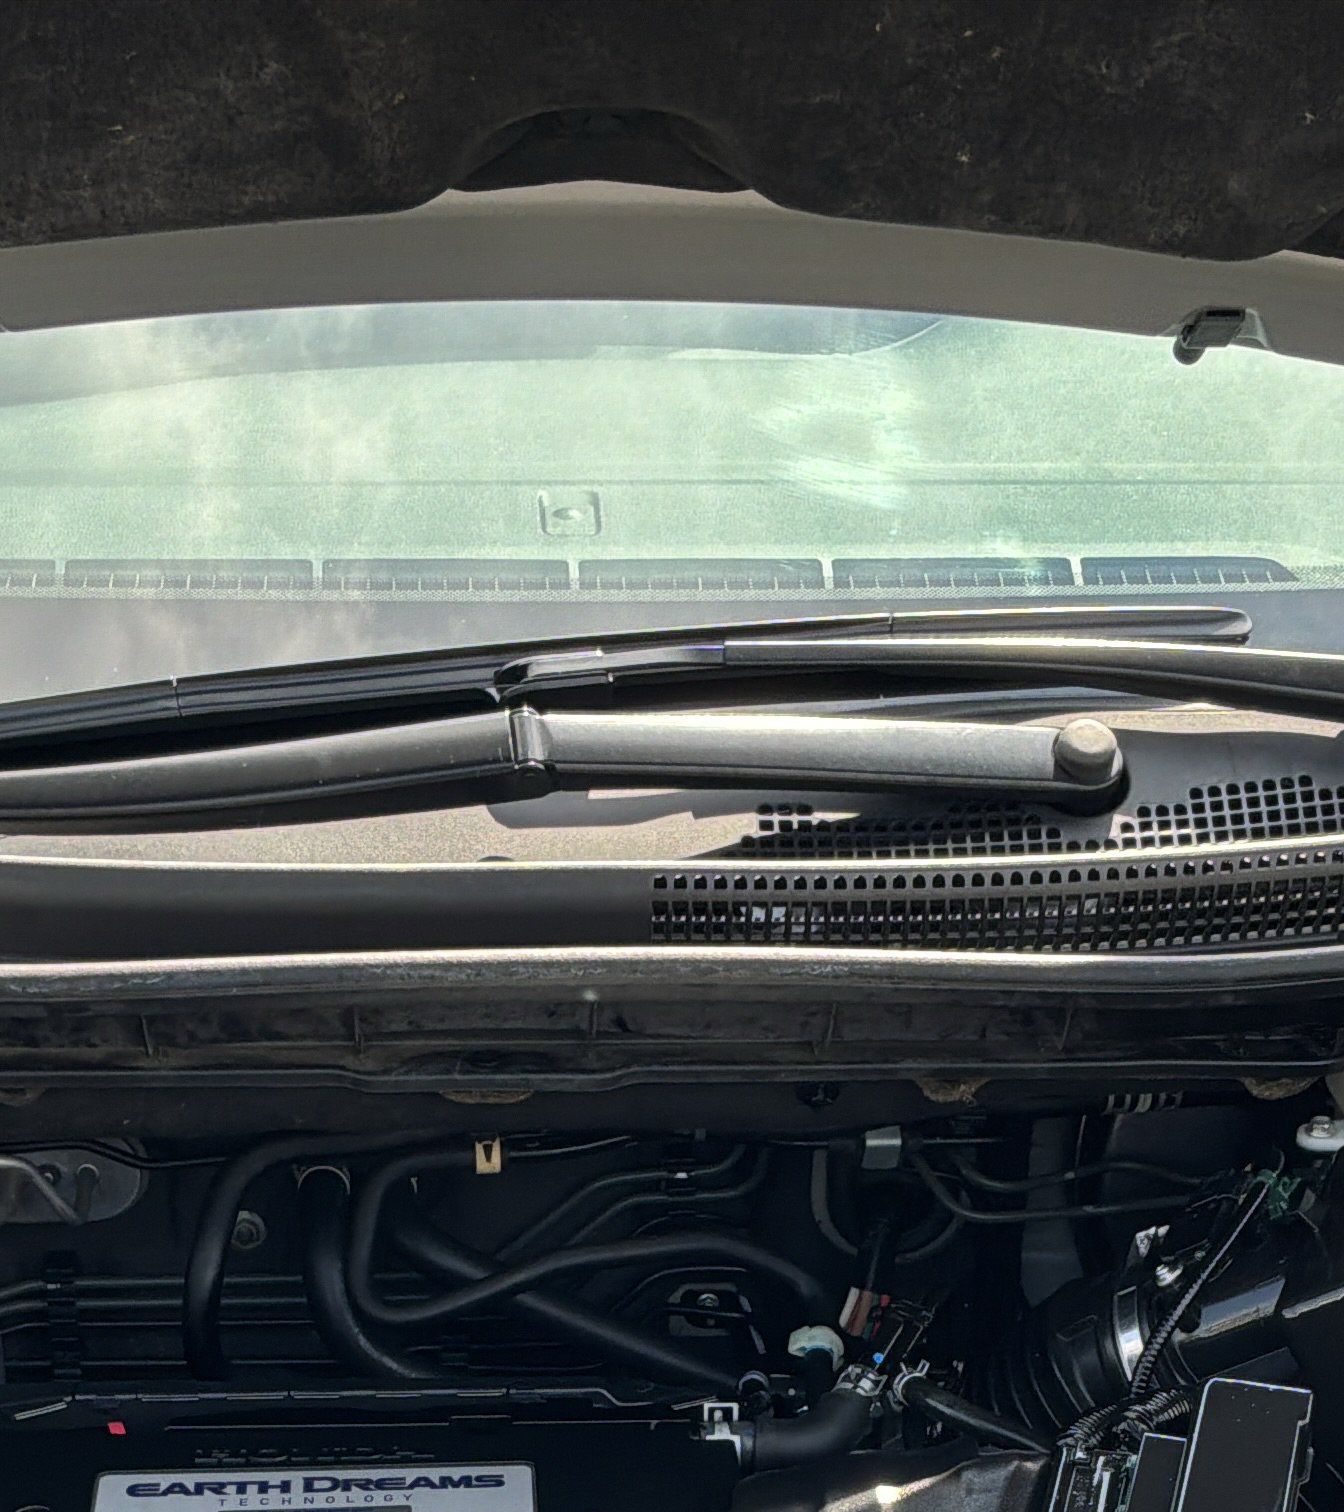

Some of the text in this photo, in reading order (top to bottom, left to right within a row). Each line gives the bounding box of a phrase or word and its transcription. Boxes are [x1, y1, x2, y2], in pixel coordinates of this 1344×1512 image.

[125, 1474, 506, 1498] EARTH DREAMS
[218, 1493, 415, 1507] TECHNOLOGY
